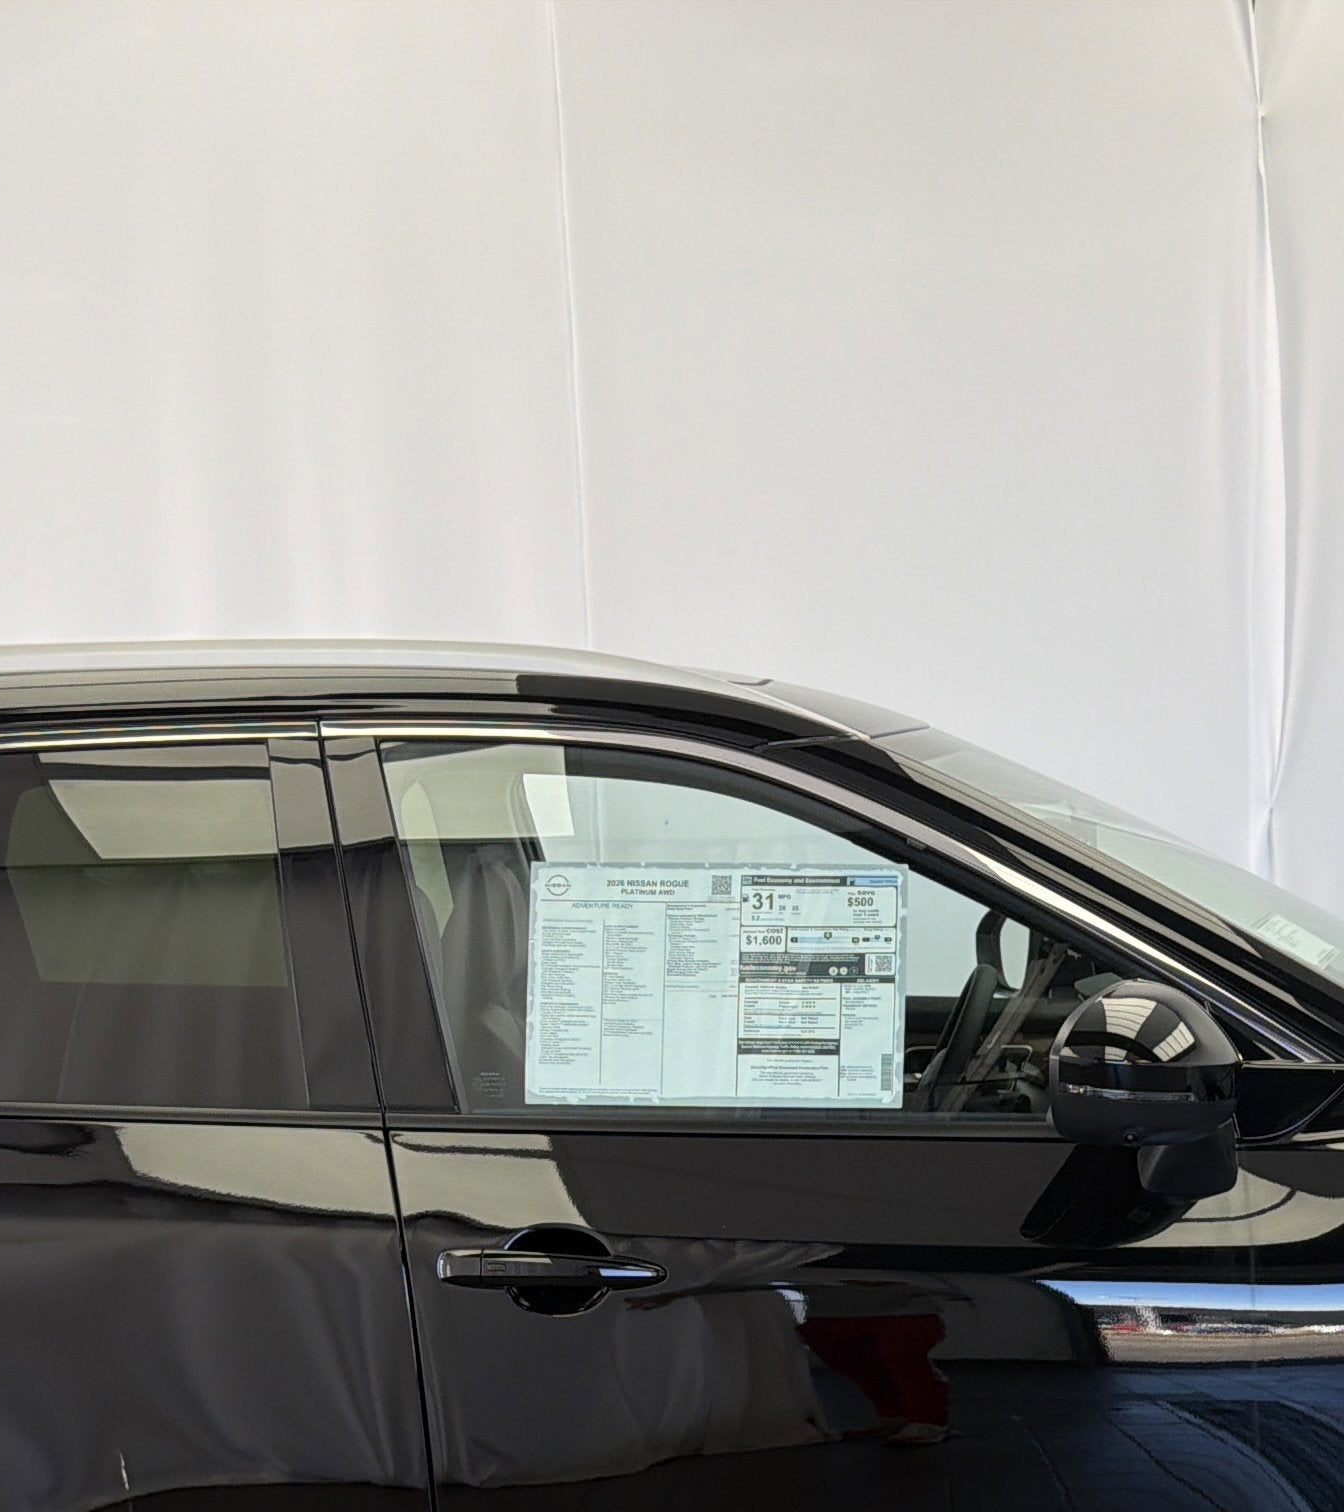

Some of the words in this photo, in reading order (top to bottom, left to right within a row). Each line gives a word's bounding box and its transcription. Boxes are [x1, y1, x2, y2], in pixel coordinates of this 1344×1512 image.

[626, 879, 657, 888] NISSAN
[659, 880, 689, 888] ROGUE
[621, 888, 657, 896] PLATINUM
[752, 892, 774, 911] 31
[847, 897, 874, 907] $500
[745, 935, 782, 946] $1,600
